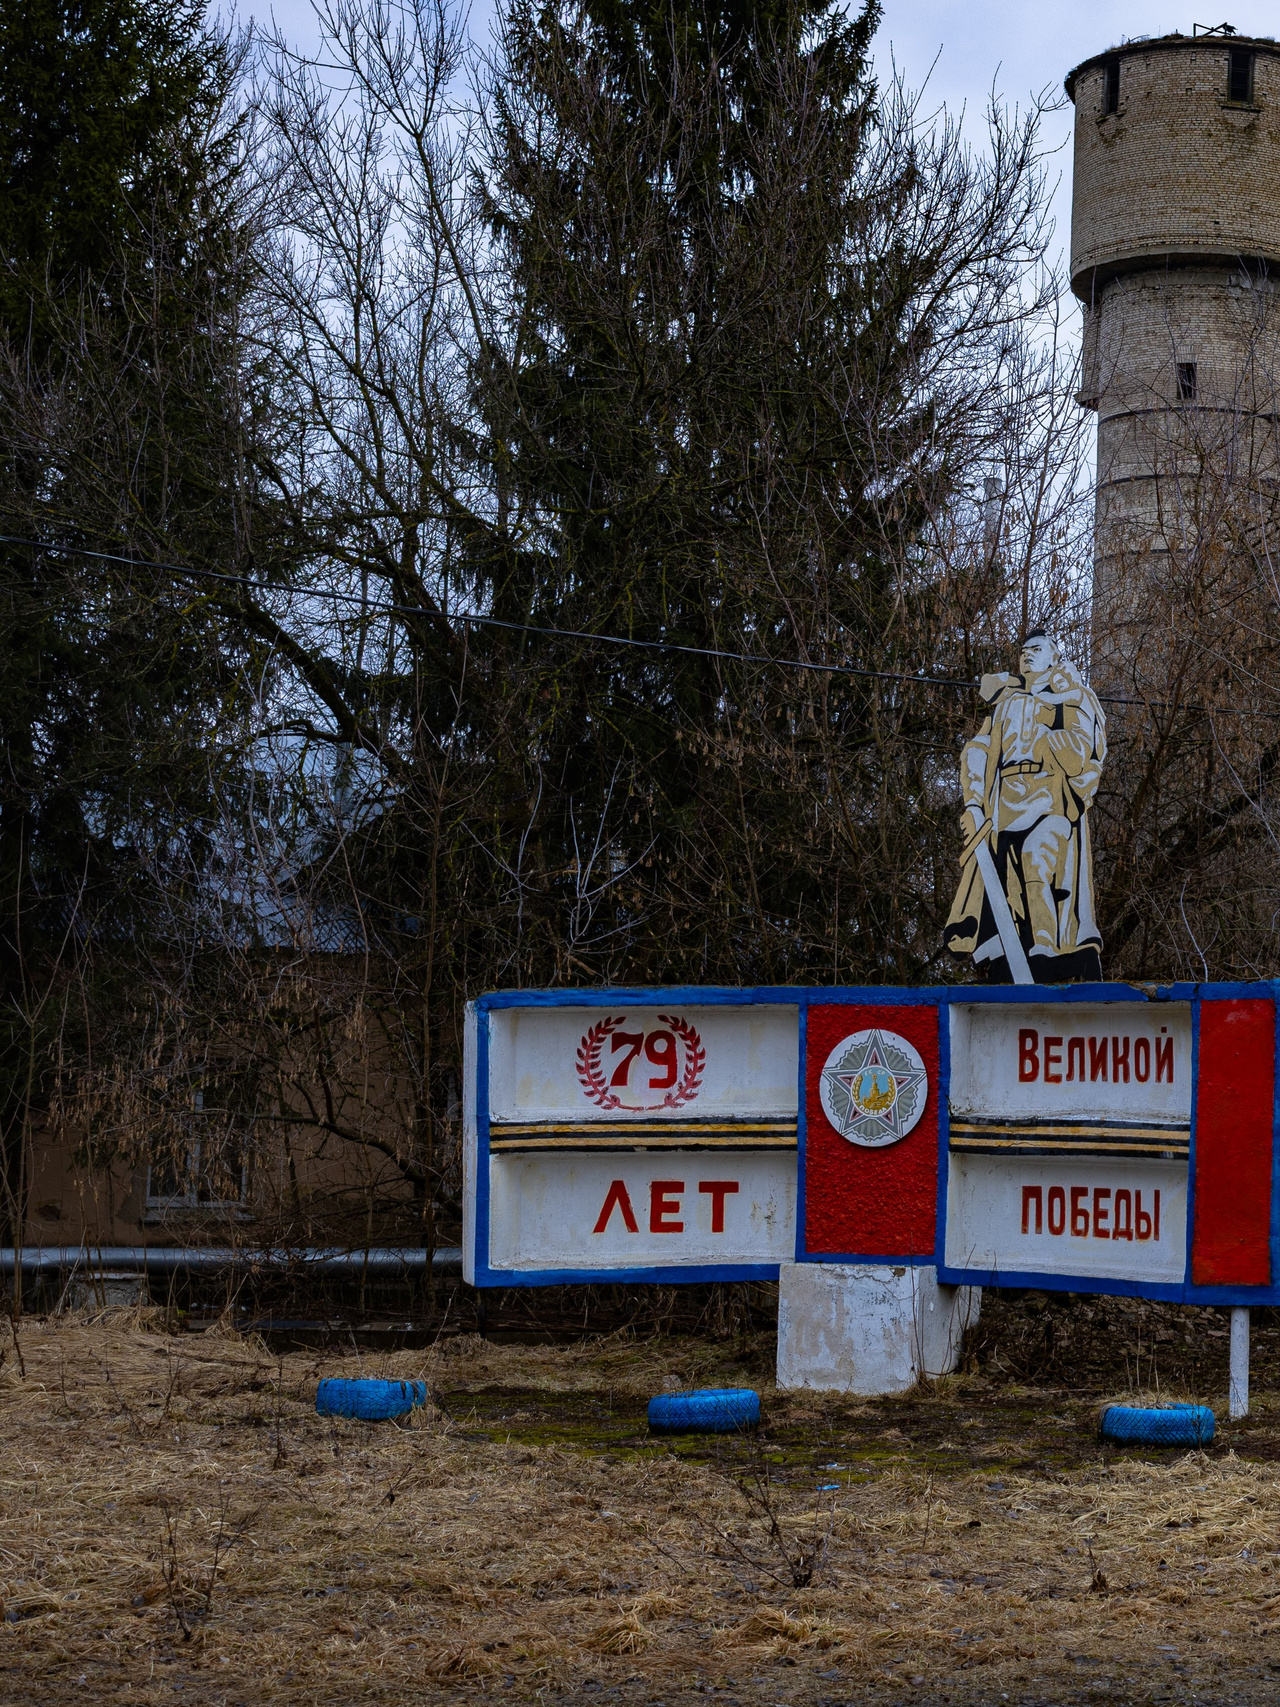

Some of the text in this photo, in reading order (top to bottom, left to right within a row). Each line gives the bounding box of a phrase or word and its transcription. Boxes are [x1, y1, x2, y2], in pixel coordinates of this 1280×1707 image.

[609, 1030, 679, 1089] 79
[1018, 1026, 1174, 1084] ВЕЛИКОЙ
[592, 1180, 740, 1234] ЛЕТ
[1021, 1185, 1161, 1243] ПОБЕДЫ
